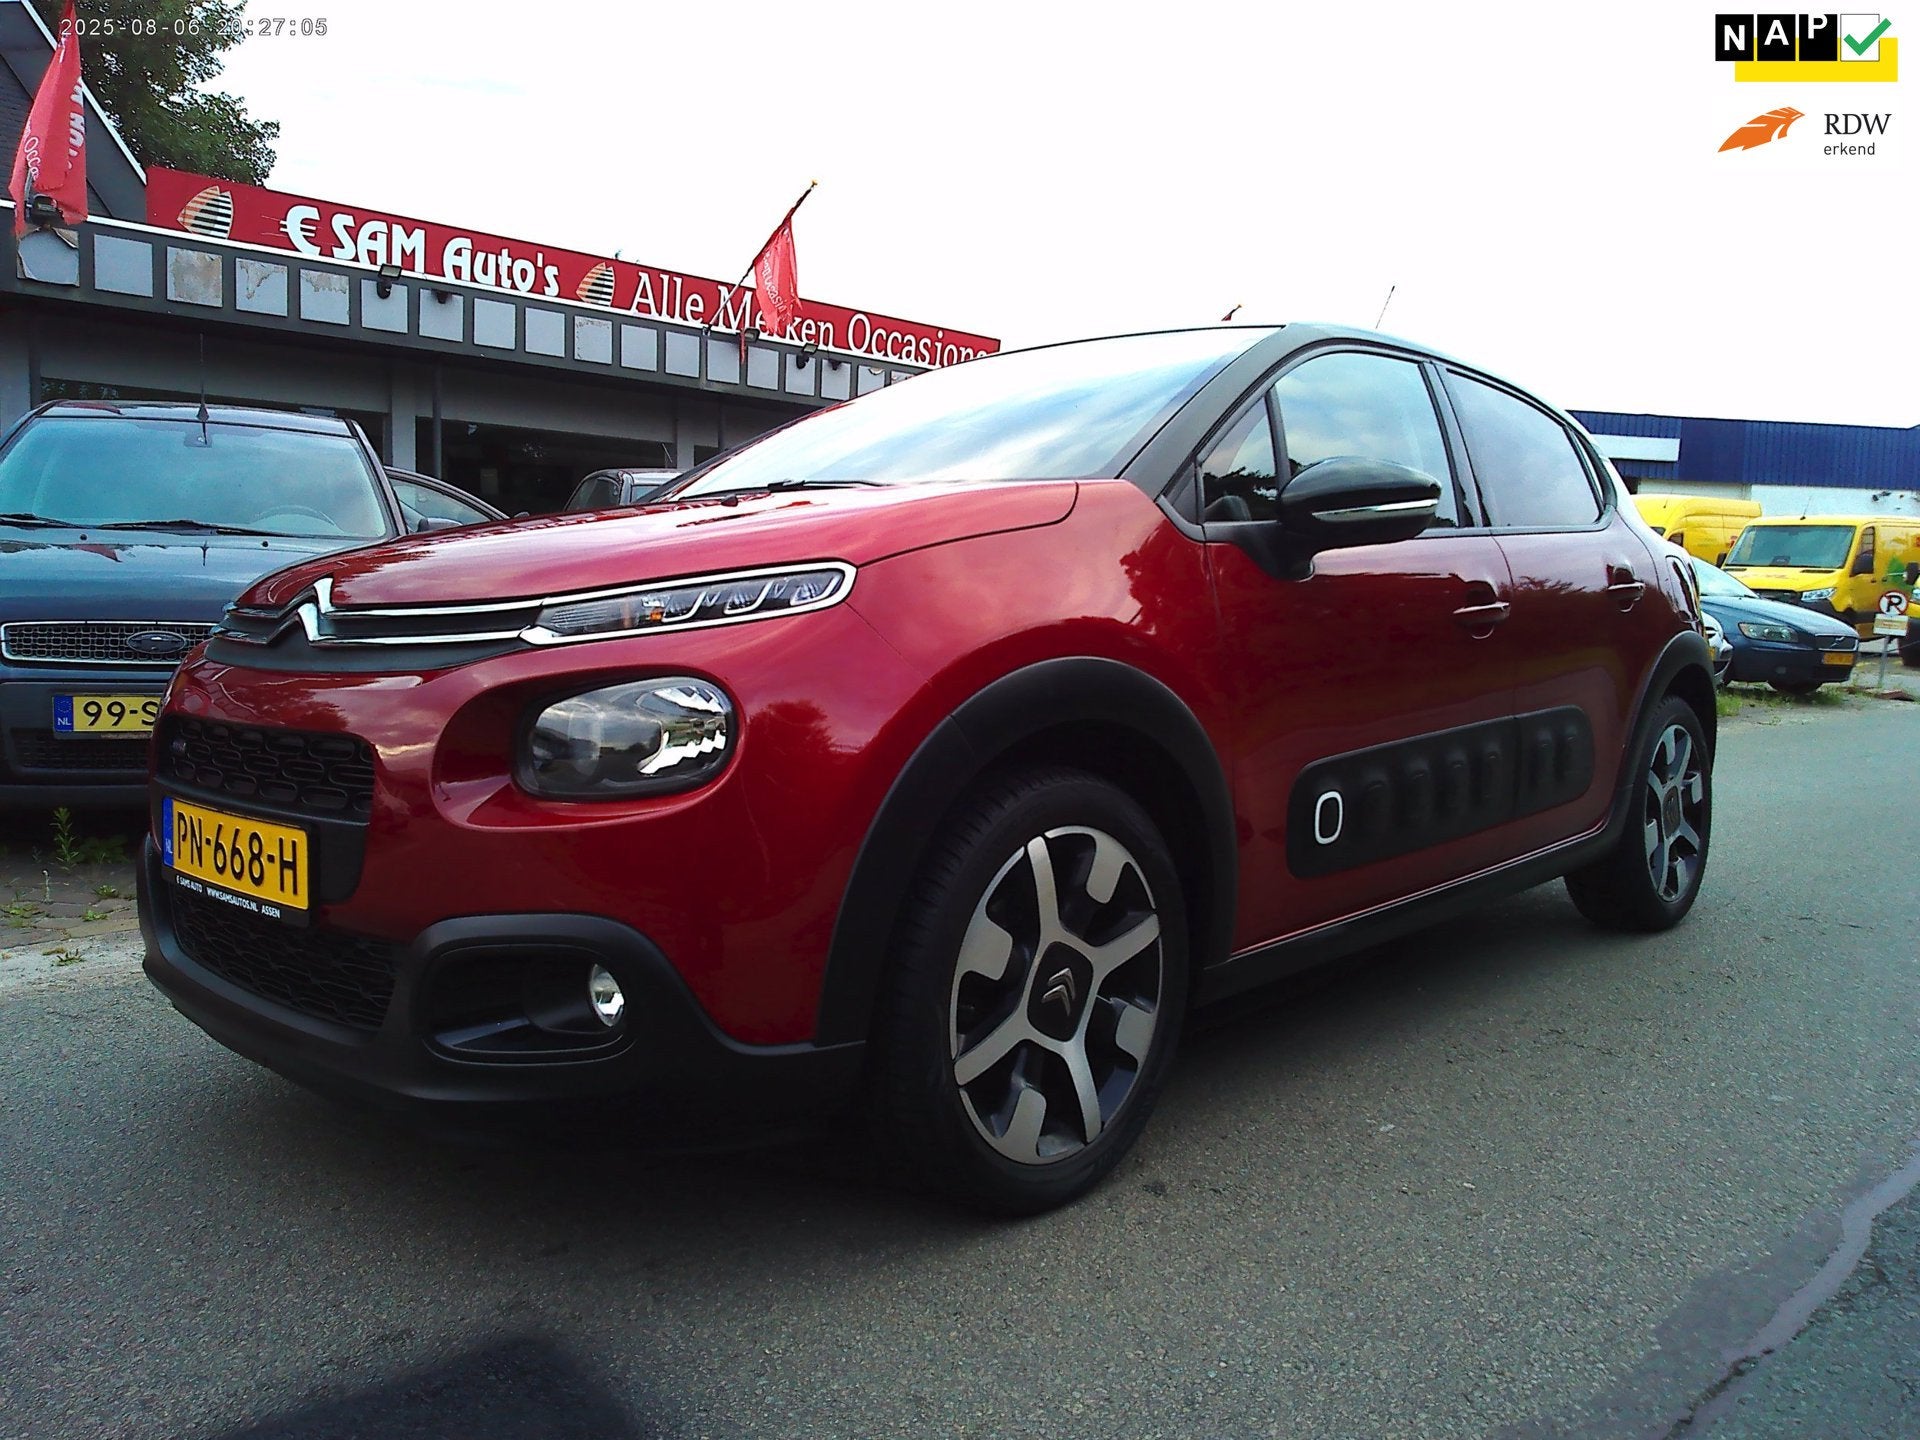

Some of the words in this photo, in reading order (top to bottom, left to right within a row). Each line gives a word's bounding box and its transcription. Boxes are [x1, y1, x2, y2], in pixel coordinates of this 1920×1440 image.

[330, 213, 425, 273] SAM
[442, 236, 560, 297] Auto's
[629, 271, 705, 324] Alle
[717, 284, 834, 349] Meken
[57, 717, 72, 726] NL
[83, 700, 159, 727] 99-S
[176, 810, 298, 896] PN-668-H
[261, 904, 281, 919] ASSEN
